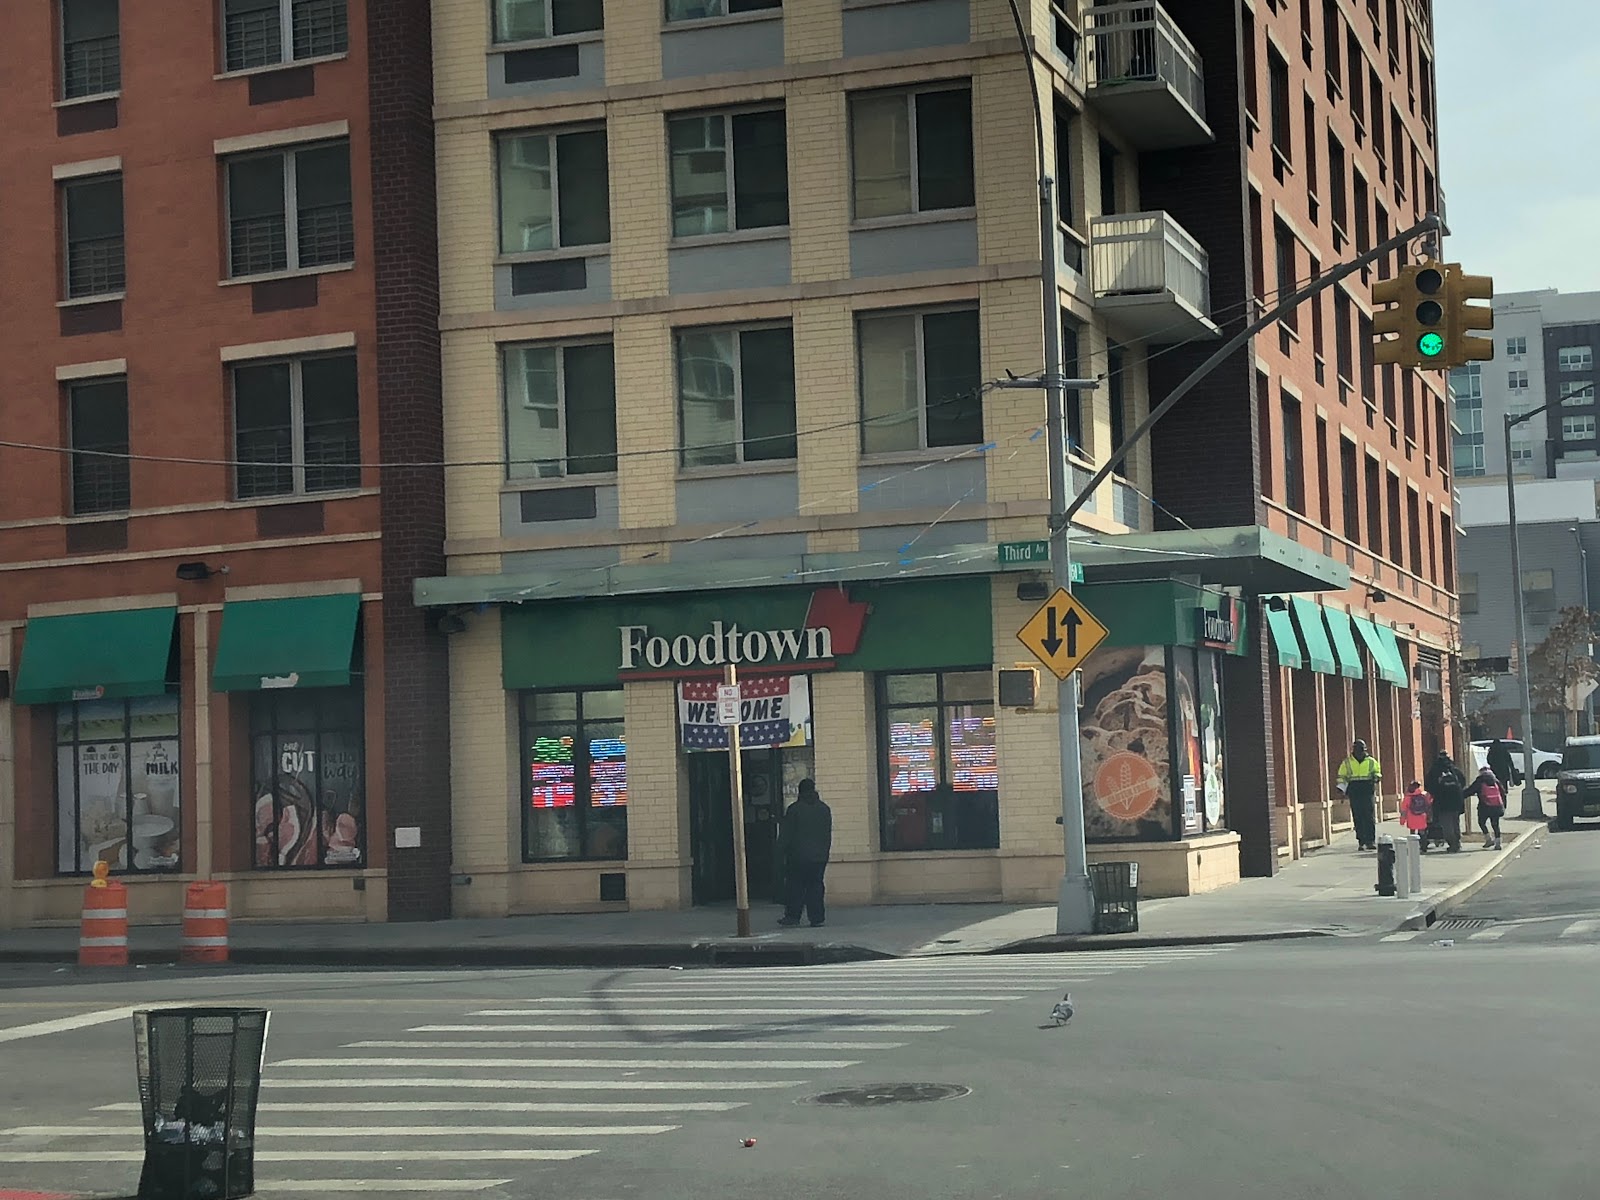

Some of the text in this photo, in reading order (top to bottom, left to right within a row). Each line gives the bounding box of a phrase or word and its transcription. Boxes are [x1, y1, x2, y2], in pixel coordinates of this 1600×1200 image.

[1003, 544, 1031, 561] Third
[617, 620, 835, 670] Foodtown
[687, 697, 783, 723] WEOME
[83, 762, 120, 775] THE DAY
[146, 761, 178, 775] MILK
[281, 751, 315, 774] CUT
